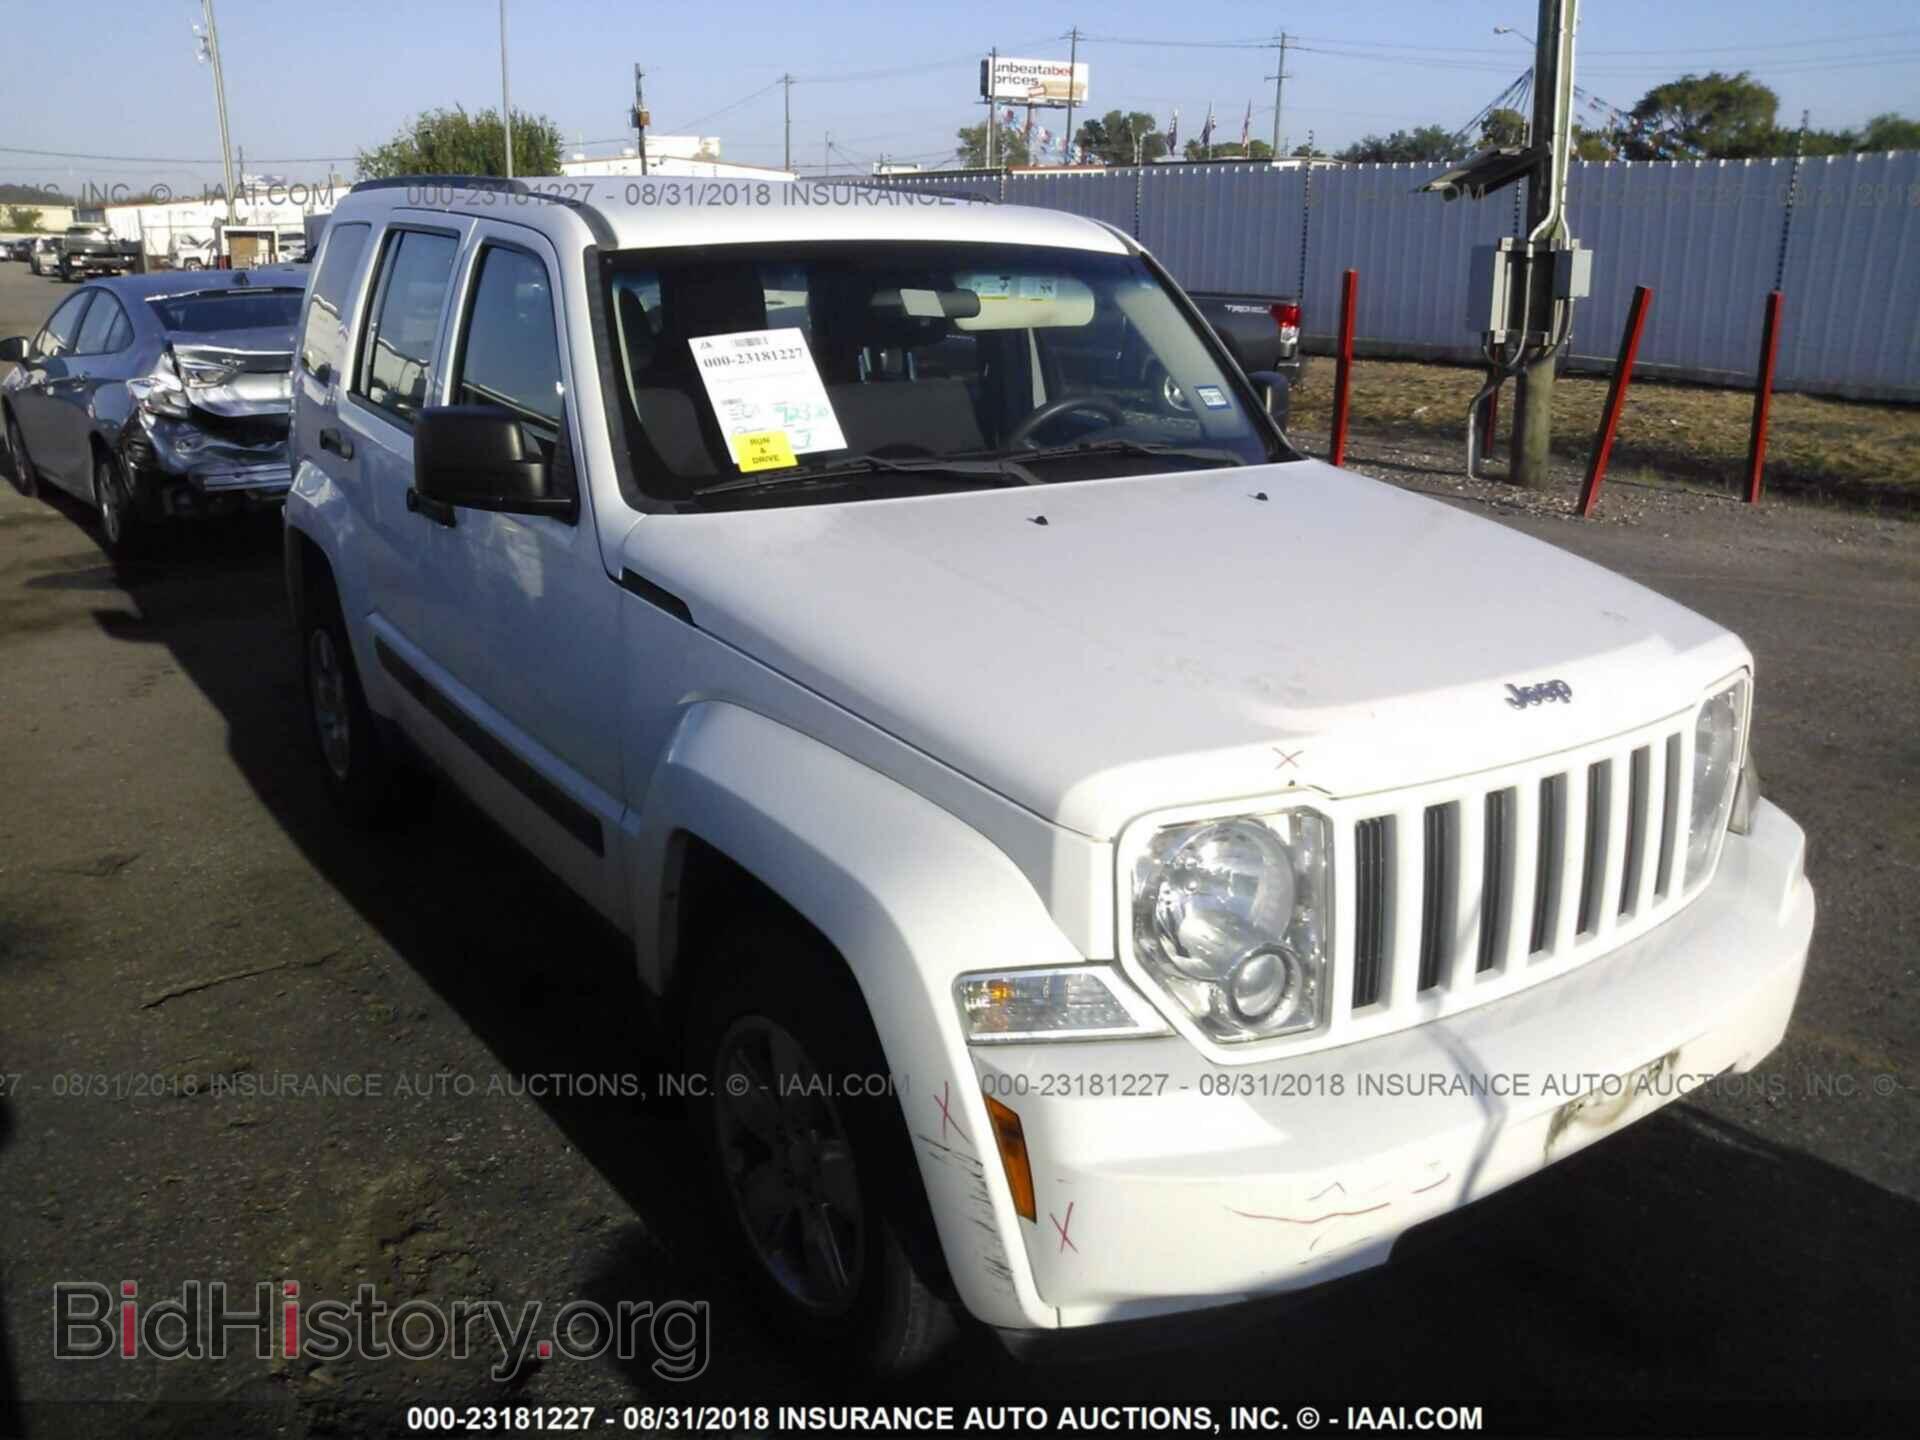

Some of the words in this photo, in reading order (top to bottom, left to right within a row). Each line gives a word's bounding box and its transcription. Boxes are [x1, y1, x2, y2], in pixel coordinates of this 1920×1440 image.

[703, 347, 803, 368] 000-23181227
[750, 437, 770, 446] RUN
[752, 454, 780, 465] DRIVE
[1503, 679, 1573, 711] Jeep
